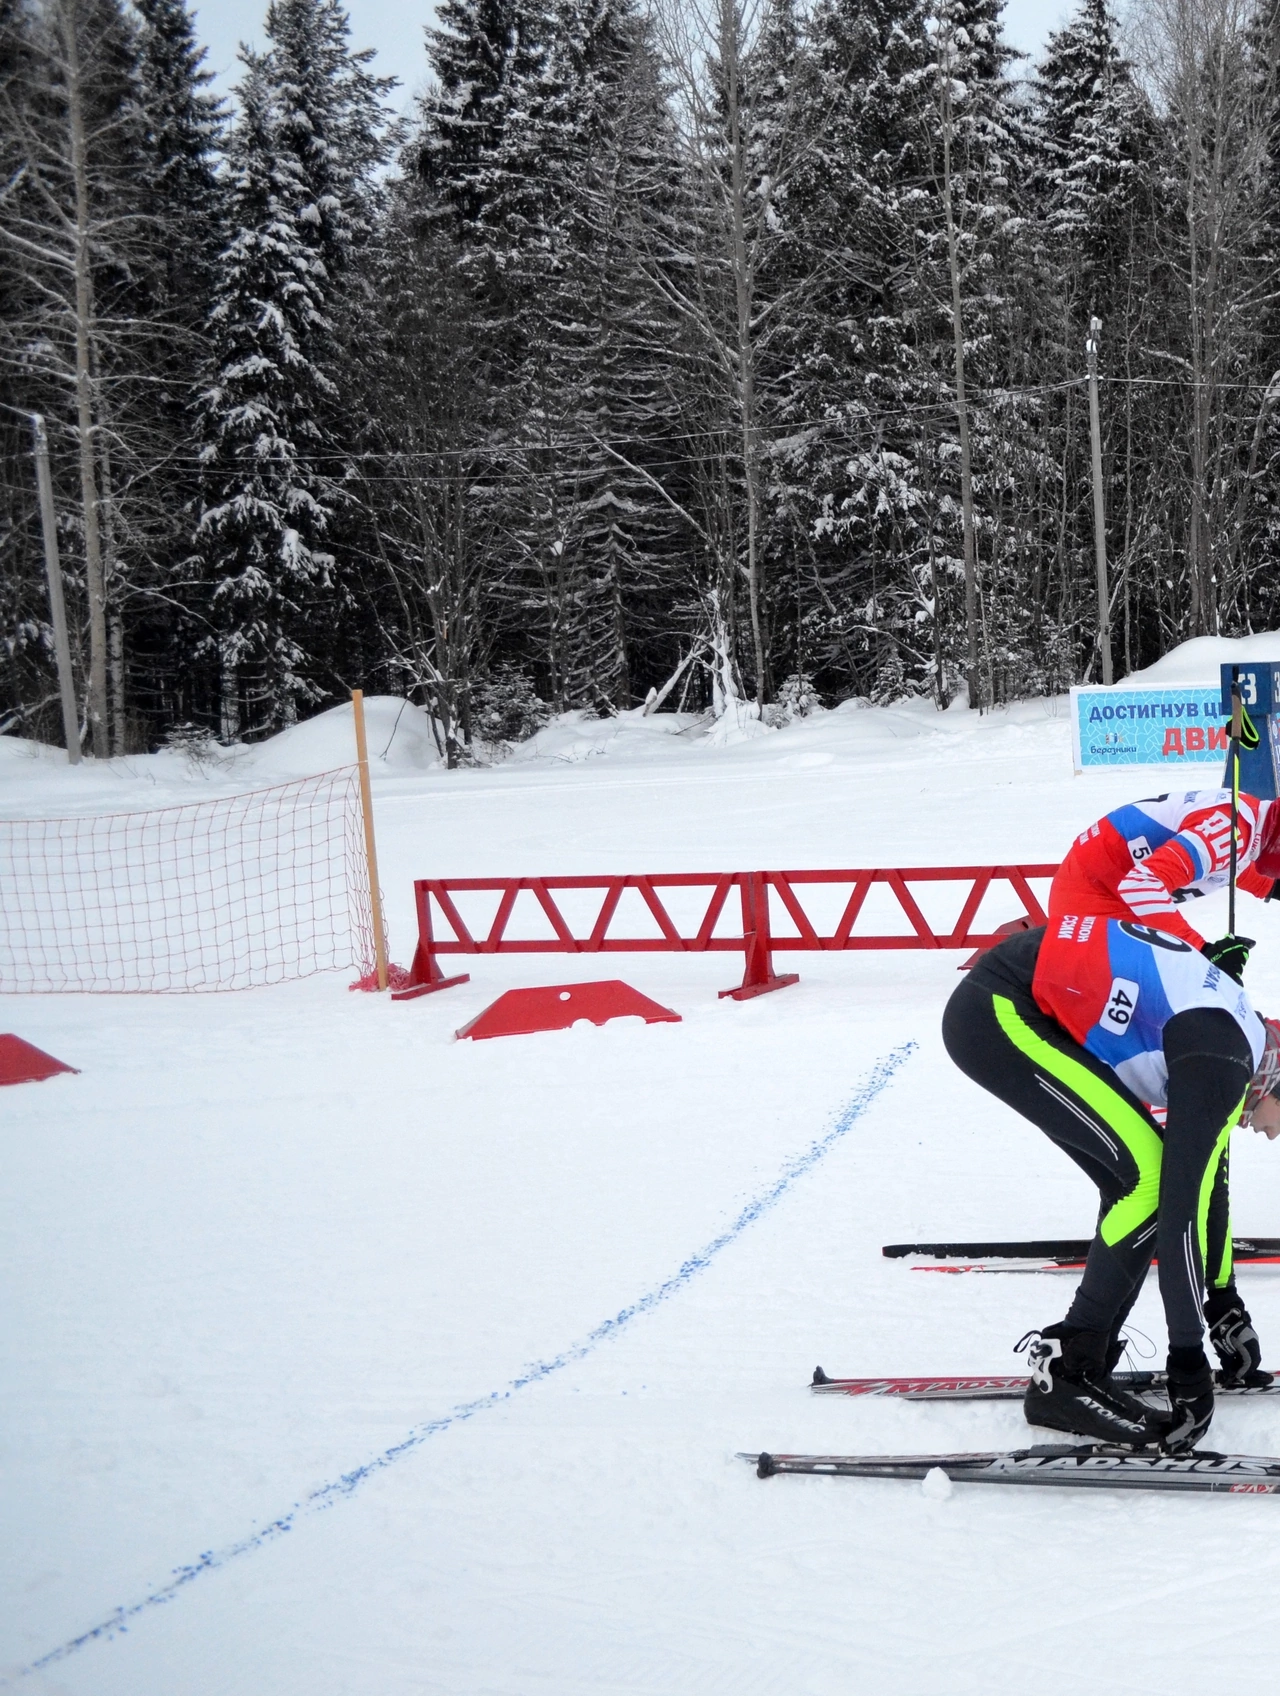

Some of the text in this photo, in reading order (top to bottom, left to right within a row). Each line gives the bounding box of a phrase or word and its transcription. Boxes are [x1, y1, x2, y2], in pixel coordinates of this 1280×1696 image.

[1237, 673, 1258, 705] 3
[1274, 671, 1280, 703] 3
[1089, 702, 1199, 722] ДОСТИГНУВ
[1132, 846, 1151, 860] 5
[1108, 989, 1133, 1025] 49
[884, 1378, 1031, 1394] MADSH
[1075, 1396, 1146, 1433] ATOMIC
[991, 1456, 1276, 1476] MADSHUS
